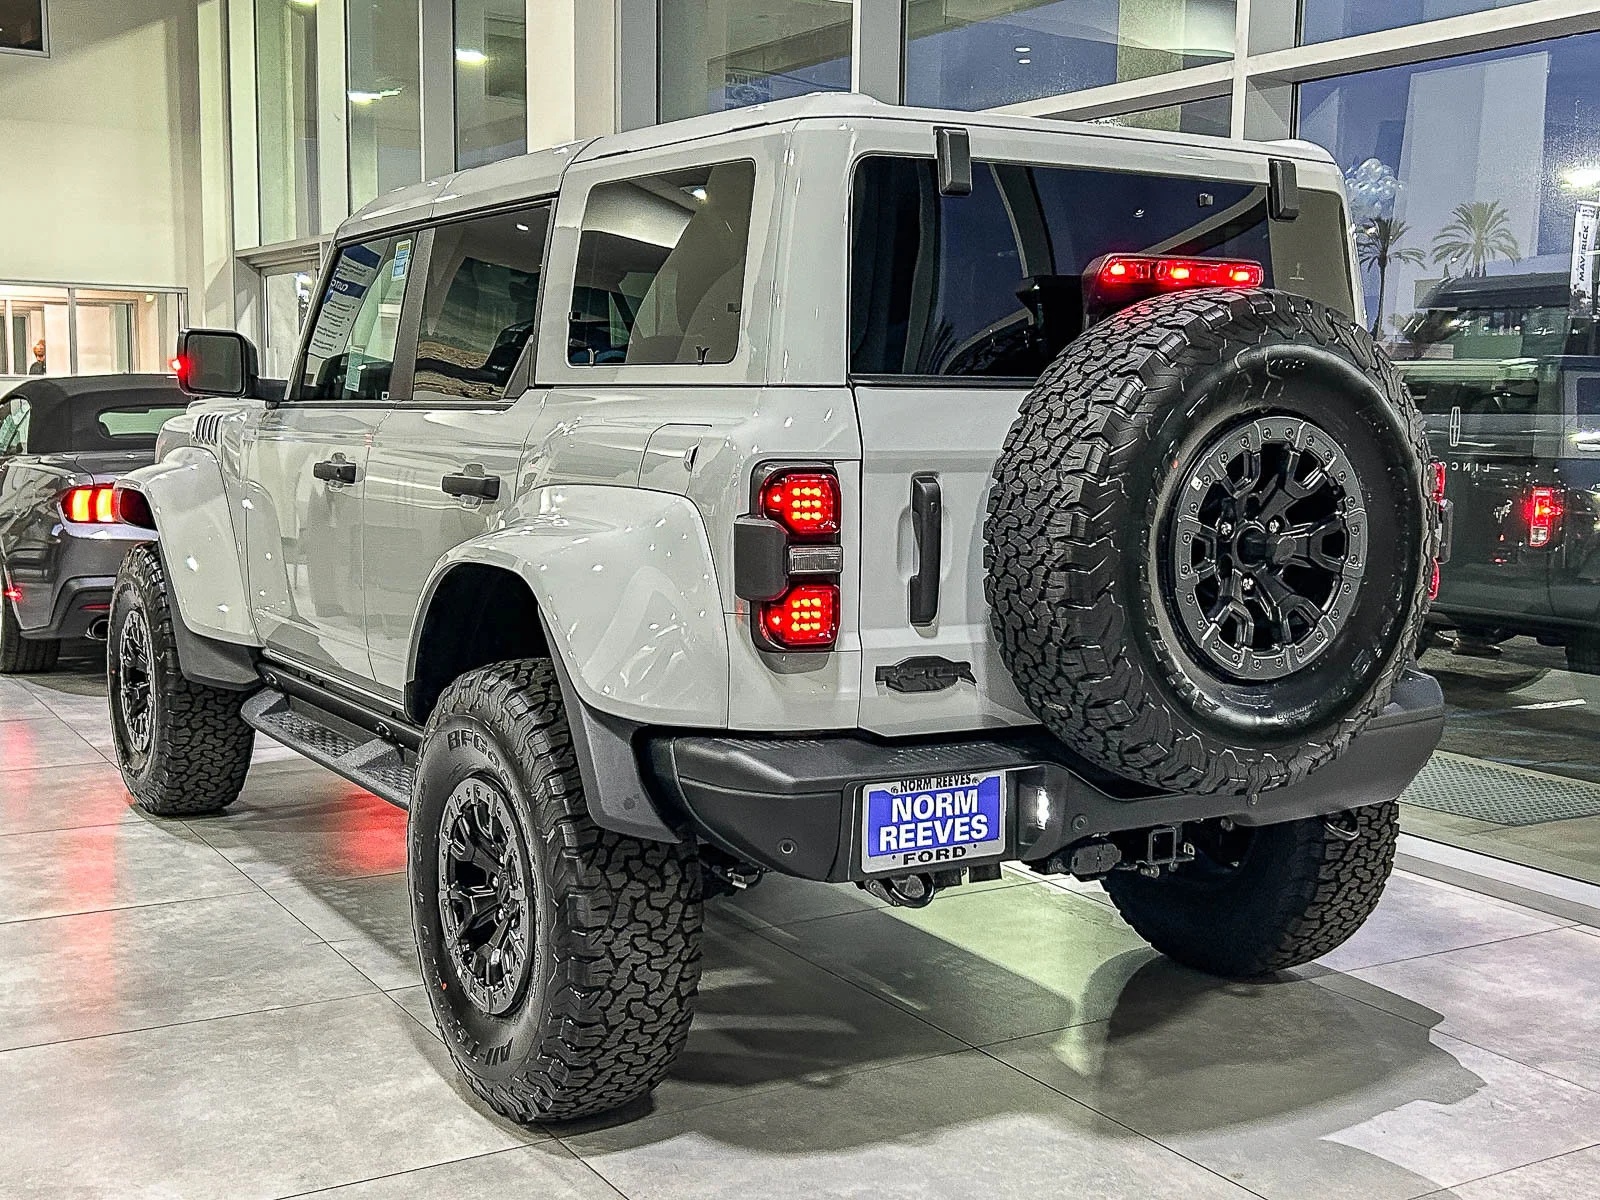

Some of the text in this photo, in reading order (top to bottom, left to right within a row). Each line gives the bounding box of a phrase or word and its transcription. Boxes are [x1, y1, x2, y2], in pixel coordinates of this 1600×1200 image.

[900, 774, 971, 792] NORM REEVES
[891, 789, 978, 823] NORM
[879, 814, 988, 852] REEVES
[903, 845, 967, 866] FORD
